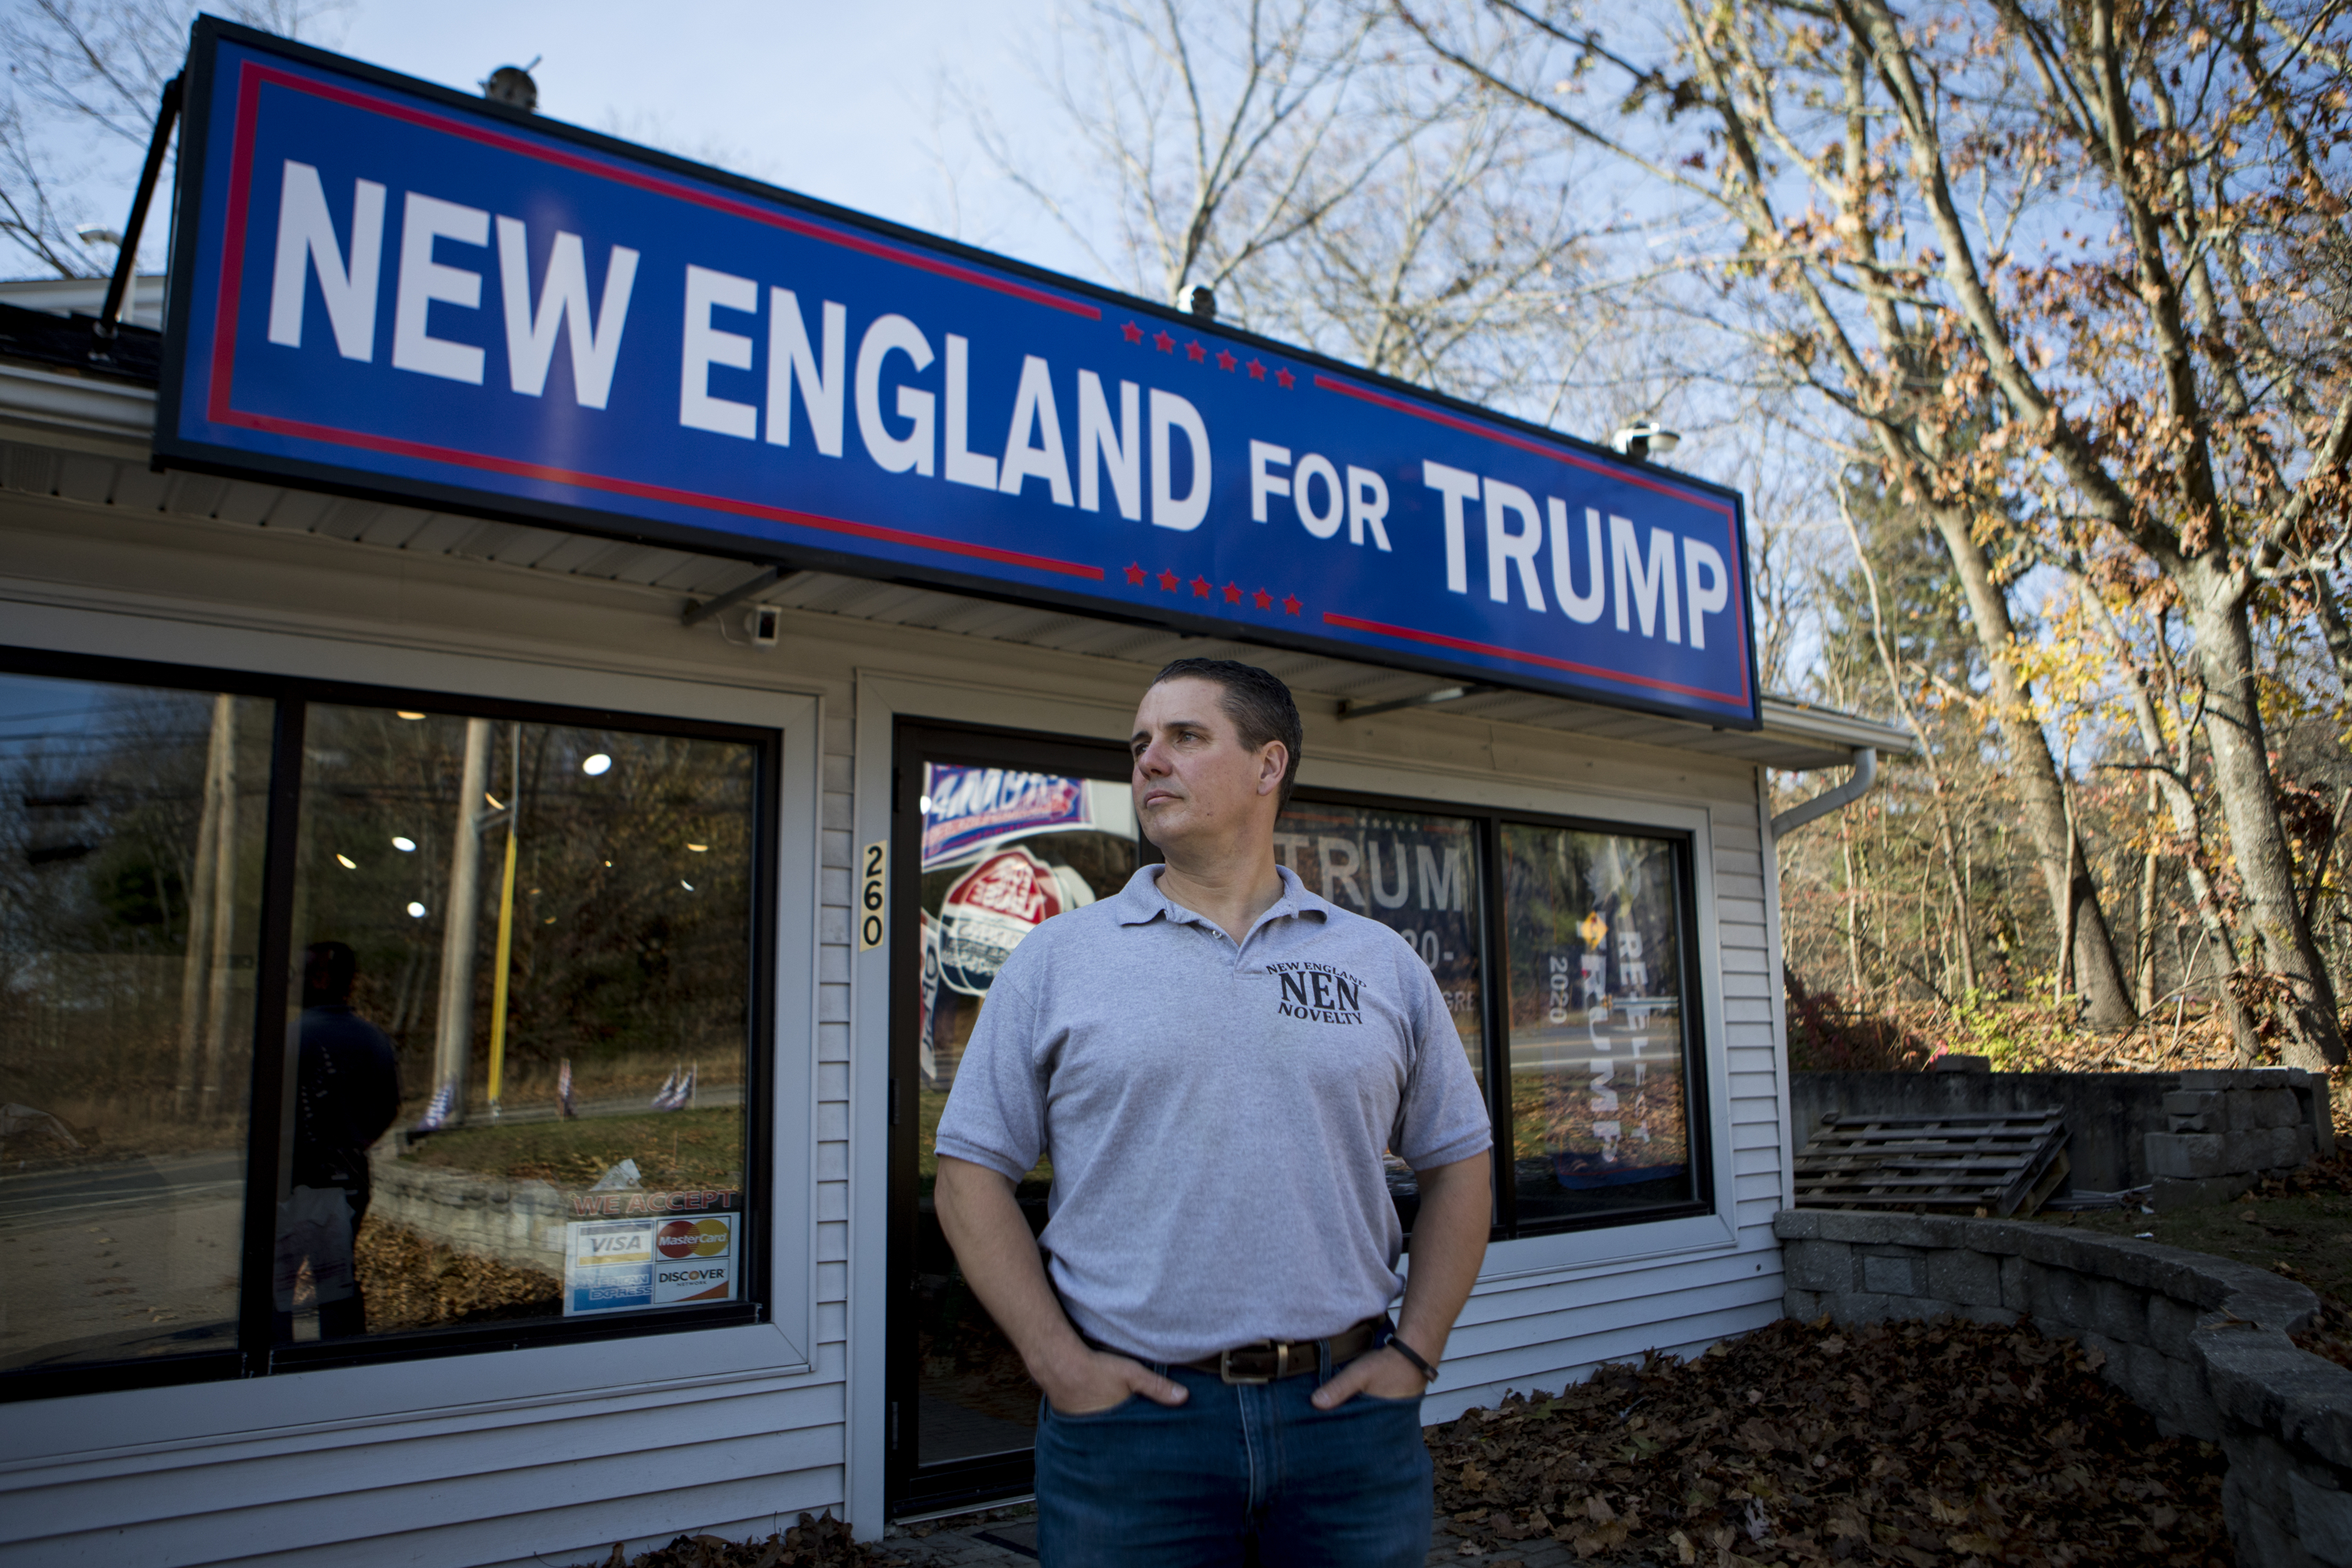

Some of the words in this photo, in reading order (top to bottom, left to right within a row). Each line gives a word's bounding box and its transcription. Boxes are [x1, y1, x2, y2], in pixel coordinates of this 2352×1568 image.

[267, 158, 641, 410] NEW
[680, 263, 1212, 532] ENGLAND
[1250, 439, 1392, 552] FOR
[1422, 459, 1728, 650] TRUMP
[1273, 833, 1472, 913] TRUM
[863, 845, 883, 946] 260
[1266, 962, 1299, 975] NEW
[1304, 962, 1367, 987] ENGLAND
[1279, 971, 1359, 1011] NEN
[1549, 956, 1570, 1024] 2020
[1278, 1002, 1363, 1025] NOVELTY
[574, 1195, 620, 1216] WE
[626, 1189, 736, 1214] ACCEPT
[590, 1236, 641, 1252] VISA
[659, 1232, 727, 1247] MasterCard
[575, 1274, 650, 1289] AMERICAN
[659, 1269, 724, 1283] DISCOVER
[590, 1286, 652, 1301] EXPRESS
